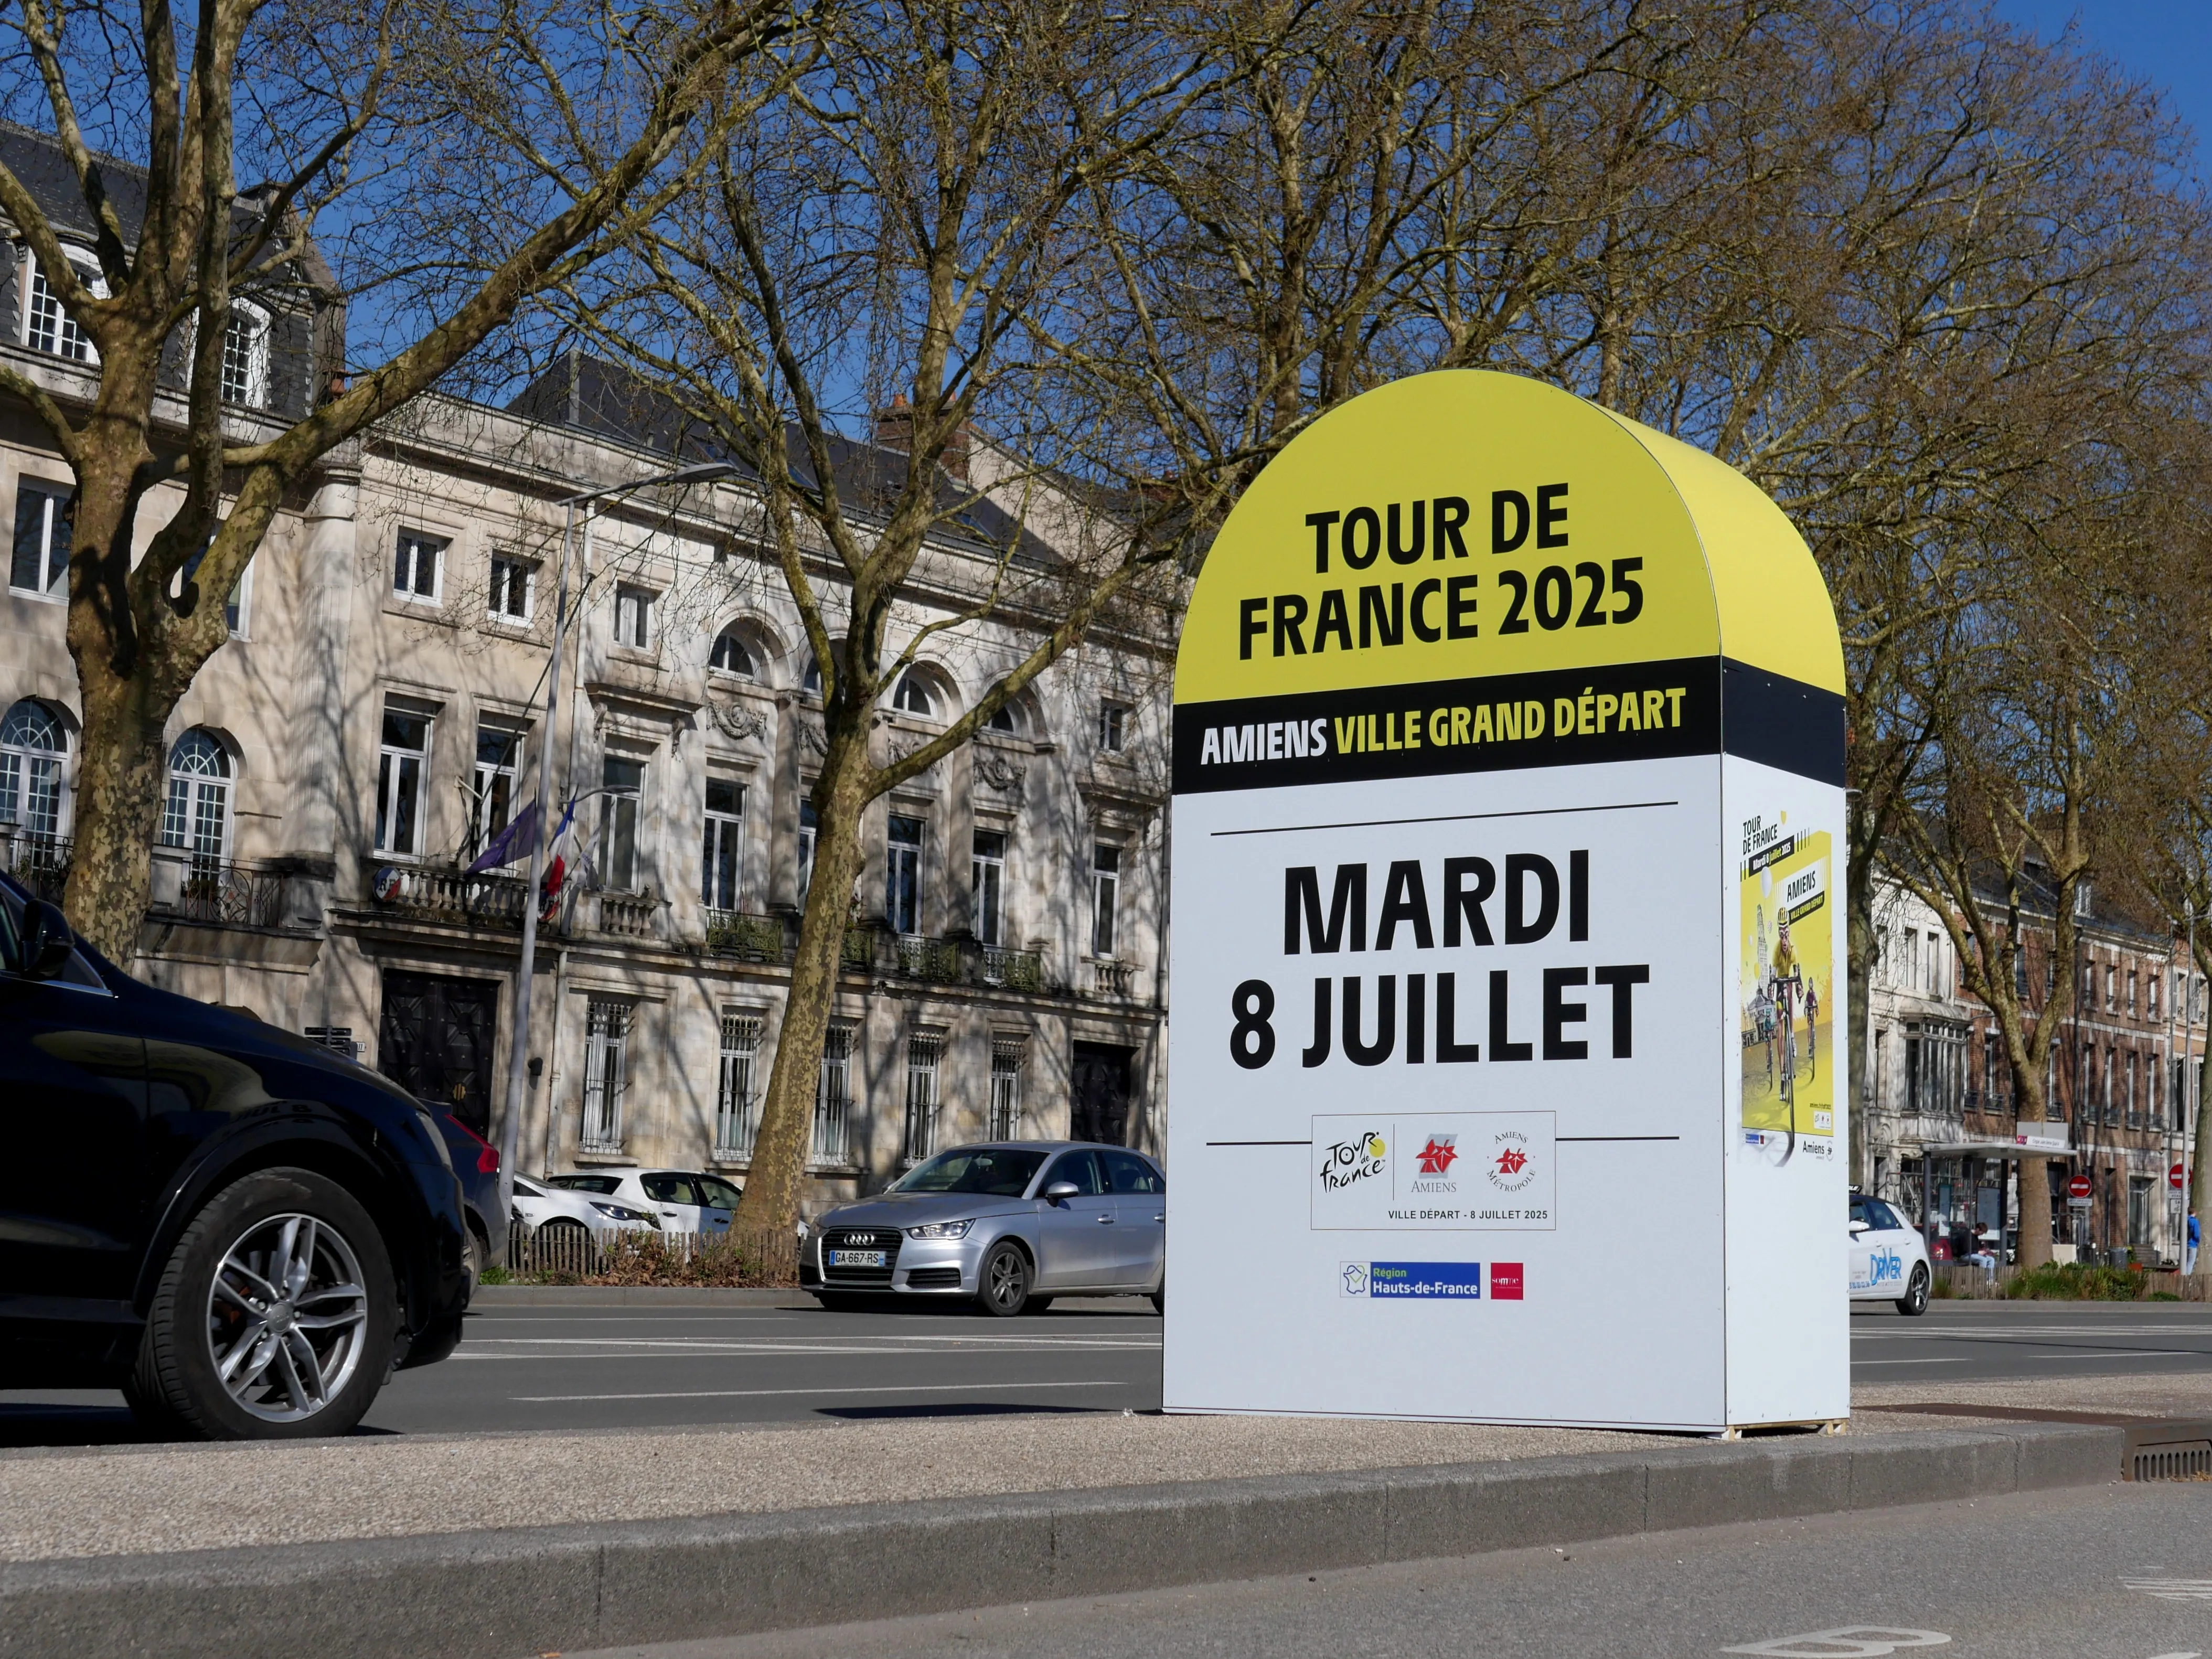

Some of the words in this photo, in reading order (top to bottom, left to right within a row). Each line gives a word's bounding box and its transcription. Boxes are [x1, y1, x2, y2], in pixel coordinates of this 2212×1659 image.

[1305, 496, 1469, 574] TOUR
[1492, 483, 1568, 554] DE
[1239, 575, 1478, 660] FRANCE
[1498, 556, 1643, 635] 2025
[1201, 718, 1327, 765] AMIENS
[1334, 710, 1421, 754] VILLE
[1429, 701, 1545, 746] GRAND
[1554, 687, 1686, 737] DÉPART
[1743, 815, 1761, 838] TOUR
[1743, 837, 1751, 855] DE
[1753, 823, 1777, 850] FRANCE
[1753, 854, 1766, 871] Mardi
[1766, 853, 1769, 864] 8
[1781, 842, 1791, 855] 2025
[1787, 871, 1815, 902] AMIENS
[1284, 849, 1589, 955] MARDI
[1230, 979, 1276, 1069] 8
[1302, 964, 1650, 1068] JUILLET
[1495, 1131, 1528, 1144] AMIENS
[1803, 1141, 1824, 1155] Amiens
[1411, 1180, 1457, 1193] AMIENS
[1487, 1169, 1536, 1192] MÉTROPOLE
[1388, 1211, 1416, 1219] VILLE
[1420, 1208, 1460, 1219] DÉPART
[1470, 1210, 1476, 1219] 8
[1479, 1210, 1521, 1219] JUILLET
[1524, 1210, 1548, 1219] 2025
[836, 1253, 879, 1264] GA-667-RS
[1870, 1248, 1901, 1286] DRIVER
[1373, 1268, 1407, 1279] Région
[1373, 1281, 1478, 1294] Hauts-de-France
